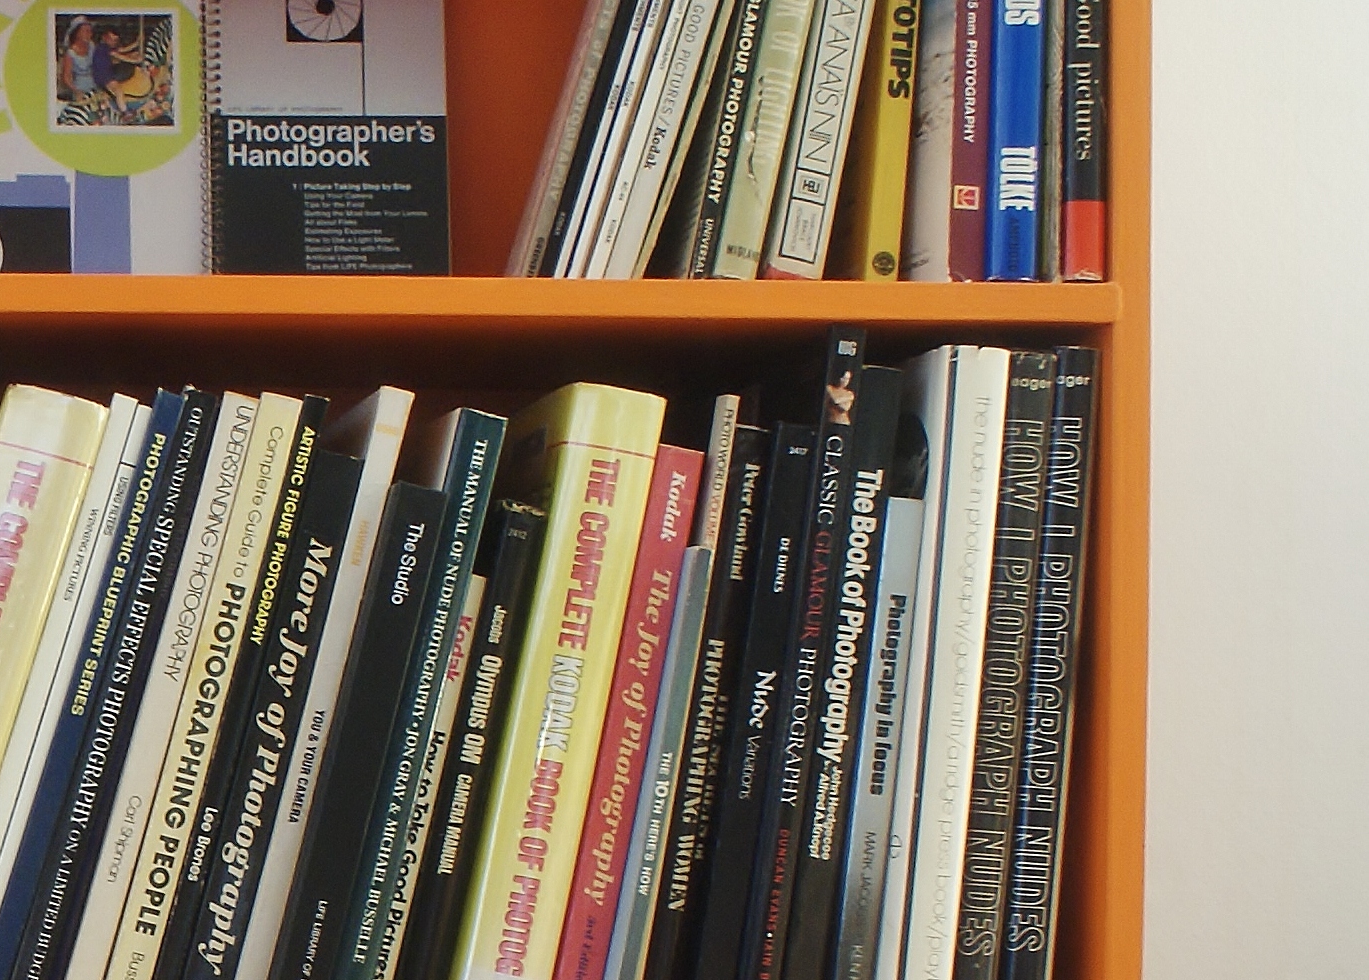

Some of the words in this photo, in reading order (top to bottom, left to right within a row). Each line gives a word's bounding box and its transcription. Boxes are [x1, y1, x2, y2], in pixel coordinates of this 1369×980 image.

[227, 119, 436, 147] Photographer's
[1067, 62, 1099, 161] pictures
[228, 143, 371, 167] Handbook
[706, 78, 743, 204] PHOTOGRAPHY
[694, 219, 714, 274] UNIVERSAL
[248, 423, 286, 508] Complete
[287, 424, 316, 485] ARTISTIC
[236, 508, 263, 559] Guide
[274, 488, 300, 540] FIGURE
[657, 470, 688, 543] Kodak
[402, 521, 425, 553] The
[231, 559, 249, 579] to
[246, 540, 287, 645] PHOTOGRAPHY
[285, 536, 334, 634] More
[387, 552, 418, 607] Studio
[642, 568, 674, 626] The
[263, 626, 312, 698] Joy
[625, 622, 662, 678] Joy
[161, 581, 247, 831] PHOTOGRAPHING
[463, 652, 503, 730] Olympus
[618, 680, 652, 716] of
[250, 700, 292, 748] of
[457, 731, 486, 765] OM
[446, 773, 472, 825] CAMERA
[580, 715, 644, 907] Photography
[192, 742, 283, 977] Photography
[435, 824, 461, 877] MANUAL
[133, 833, 182, 937] PEOPLE
